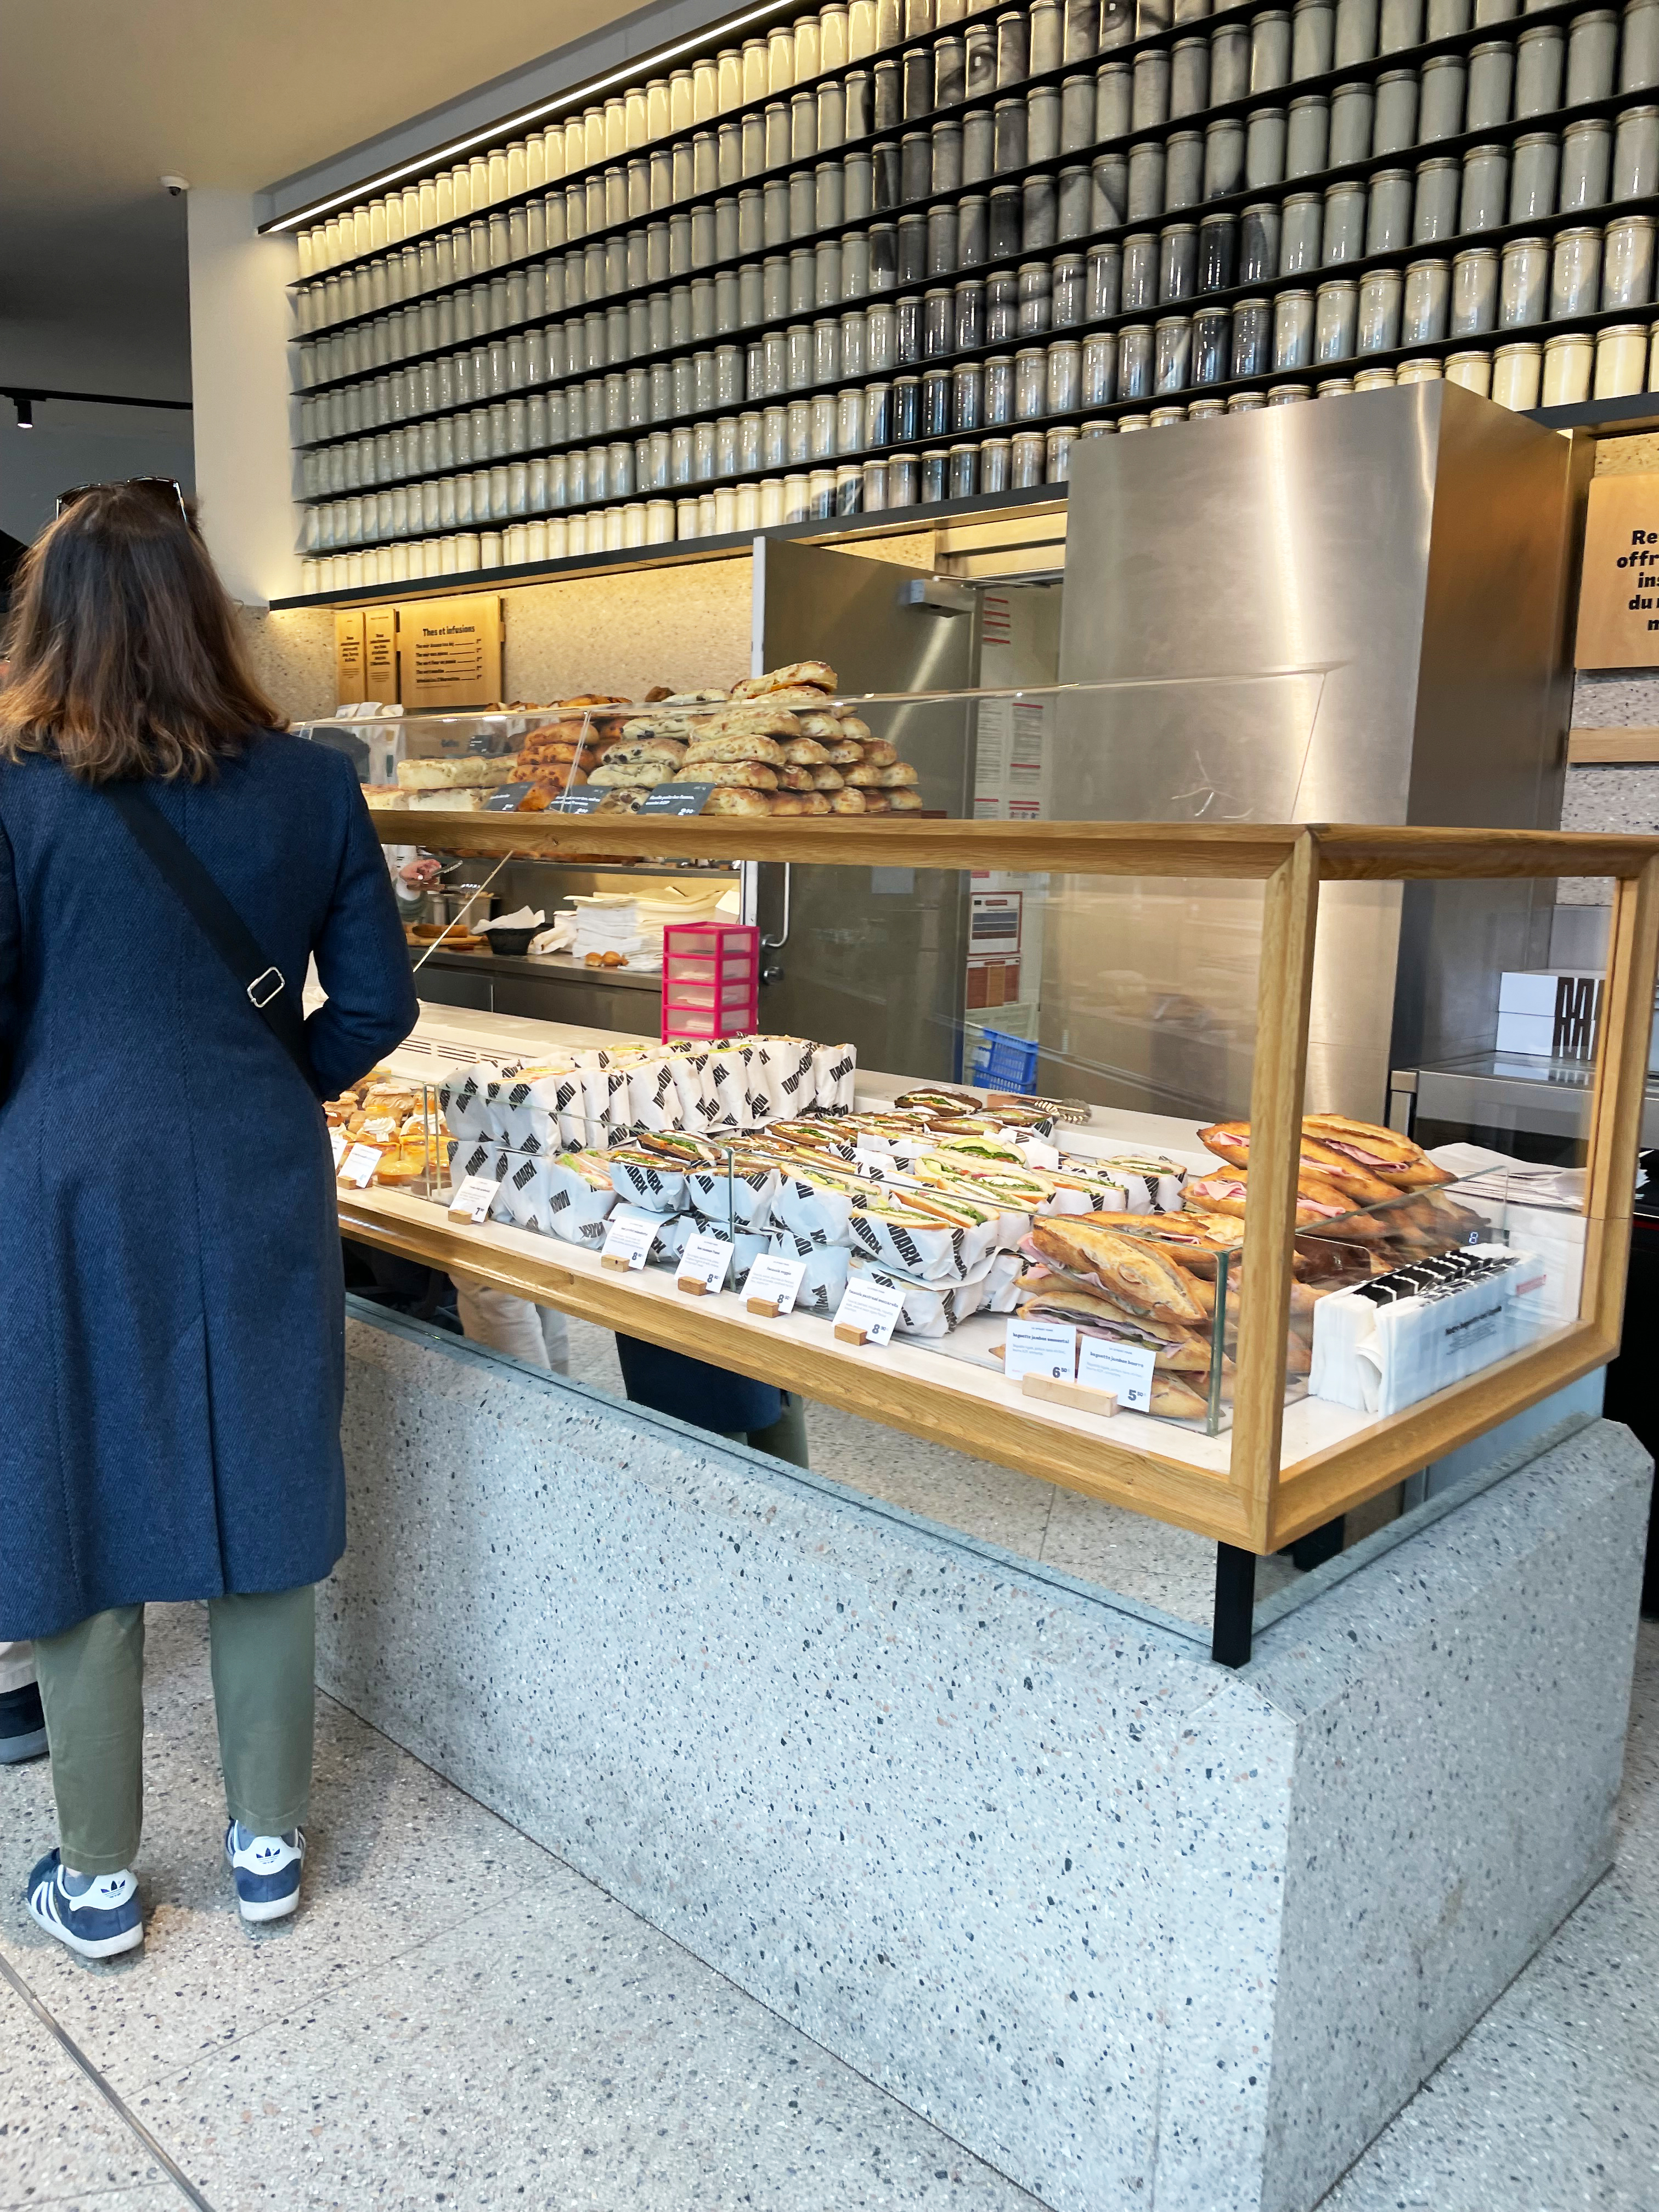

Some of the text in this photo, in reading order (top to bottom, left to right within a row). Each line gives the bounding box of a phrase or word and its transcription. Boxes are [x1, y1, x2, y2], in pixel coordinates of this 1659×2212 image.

[1632, 530, 1659, 545] Re
[1629, 595, 1652, 610] du
[512, 1159, 538, 1191] MARX
[647, 1169, 664, 1195] ARX
[887, 1223, 924, 1267] MARX
[707, 1273, 713, 1283] 8
[777, 1294, 784, 1304] 8
[872, 1324, 880, 1334] 8
[1053, 1367, 1060, 1378] 6
[1128, 1389, 1136, 1401] 5
